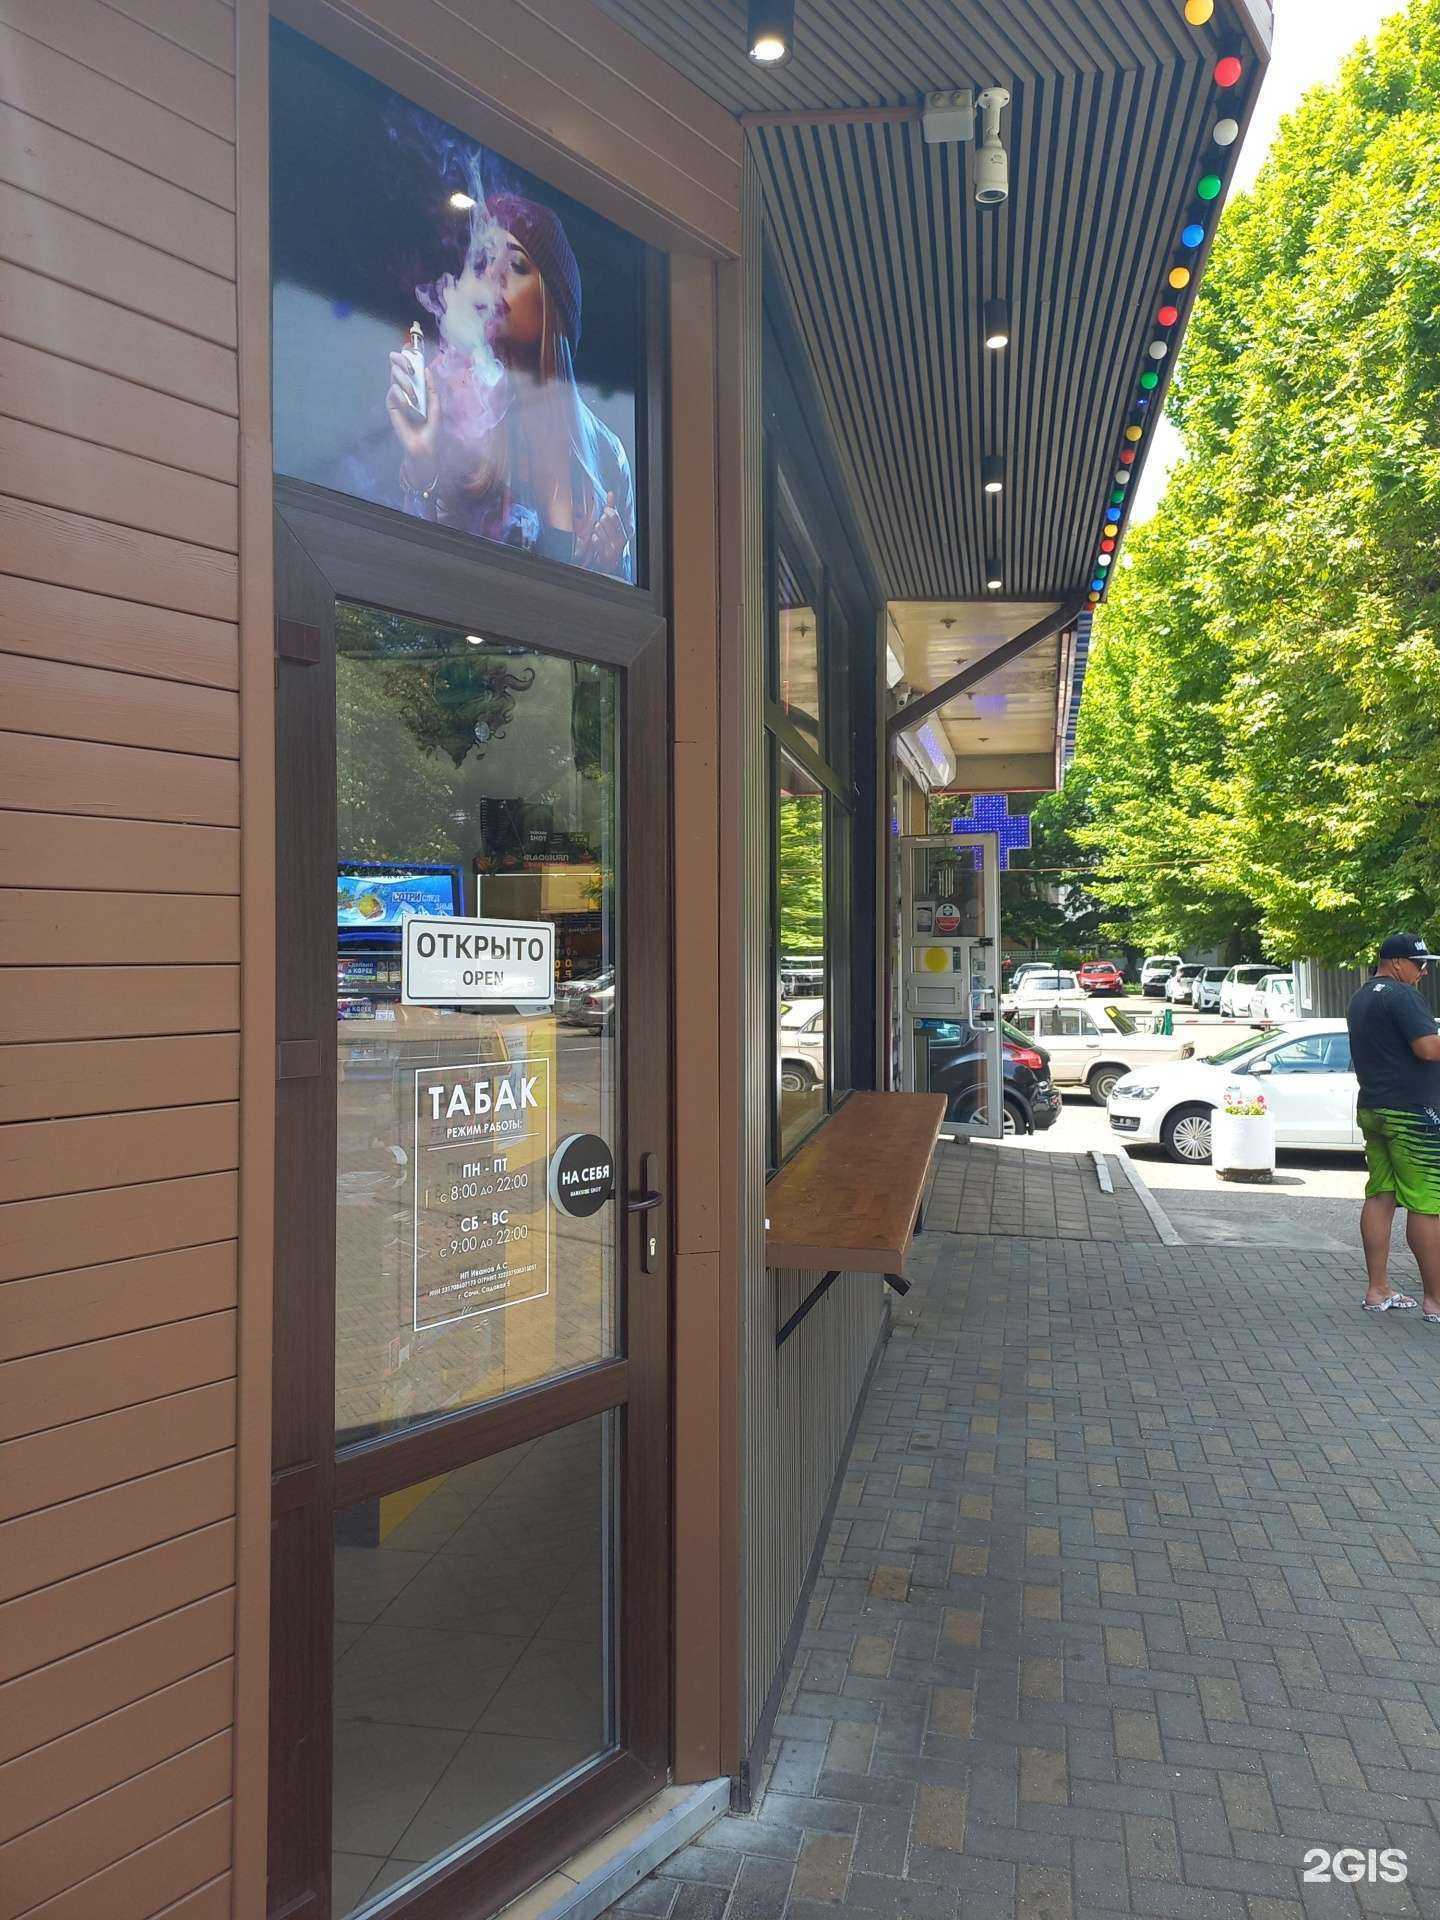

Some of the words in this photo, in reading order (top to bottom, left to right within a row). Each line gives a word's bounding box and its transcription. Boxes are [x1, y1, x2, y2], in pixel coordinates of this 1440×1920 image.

[416, 931, 544, 962] ОТКРЫТО
[462, 970, 504, 986] OPEN
[428, 1076, 538, 1120] ТАБАК
[446, 1124, 482, 1139] РЕЖИМ
[483, 1119, 523, 1134] РАБОТЫ:
[462, 1162, 481, 1178] ПН
[493, 1157, 508, 1173] ПТ
[562, 1170, 580, 1185] НА
[581, 1164, 610, 1182] СЕБЯ
[450, 1182, 478, 1201] 8:00
[496, 1173, 528, 1192] 22:00
[460, 1215, 479, 1232] СБ
[491, 1209, 509, 1225] ВС
[450, 1236, 478, 1254] 9:00
[496, 1224, 528, 1244] 22:00
[460, 1270, 470, 1280] ИП
[470, 1266, 495, 1277] Иванов
